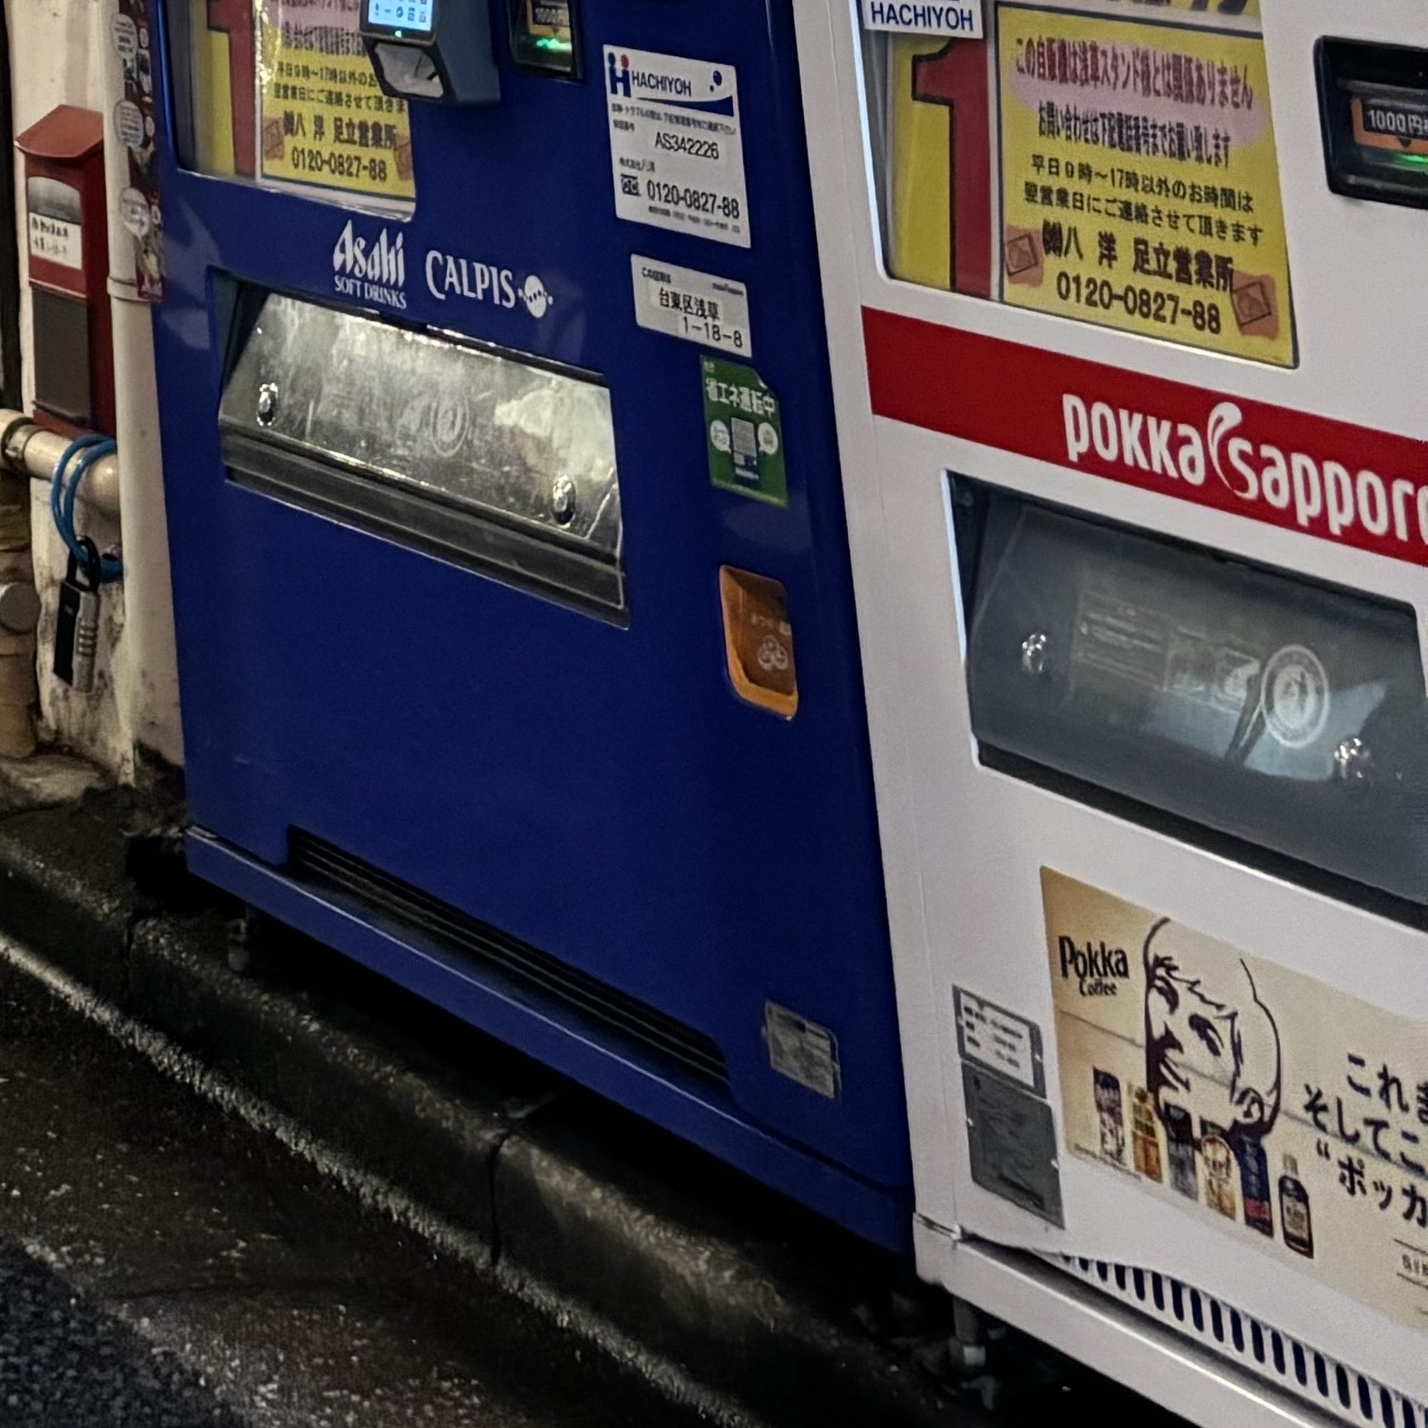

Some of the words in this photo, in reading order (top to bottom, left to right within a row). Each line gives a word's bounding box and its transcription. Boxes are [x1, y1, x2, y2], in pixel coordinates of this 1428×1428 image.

[870, 1, 974, 32] HACHIYOH
[631, 71, 693, 98] HACHIYOH
[291, 150, 388, 183] 0120-0827-88
[645, 178, 741, 220] 0120-0827-88
[333, 218, 407, 286] Asahi
[1131, 236, 1235, 294] 足立営業所
[333, 276, 363, 301] SOFT
[364, 280, 408, 311] DRINKS
[425, 249, 517, 310] CALPIS
[658, 287, 722, 322] 台東区浅草
[1055, 271, 1222, 336] 0120-0827-88
[682, 315, 744, 349] 1-18-8
[704, 376, 778, 417] 省エネ運転中
[1058, 935, 1130, 982] Pokka
[1078, 976, 1119, 998] Coffee
